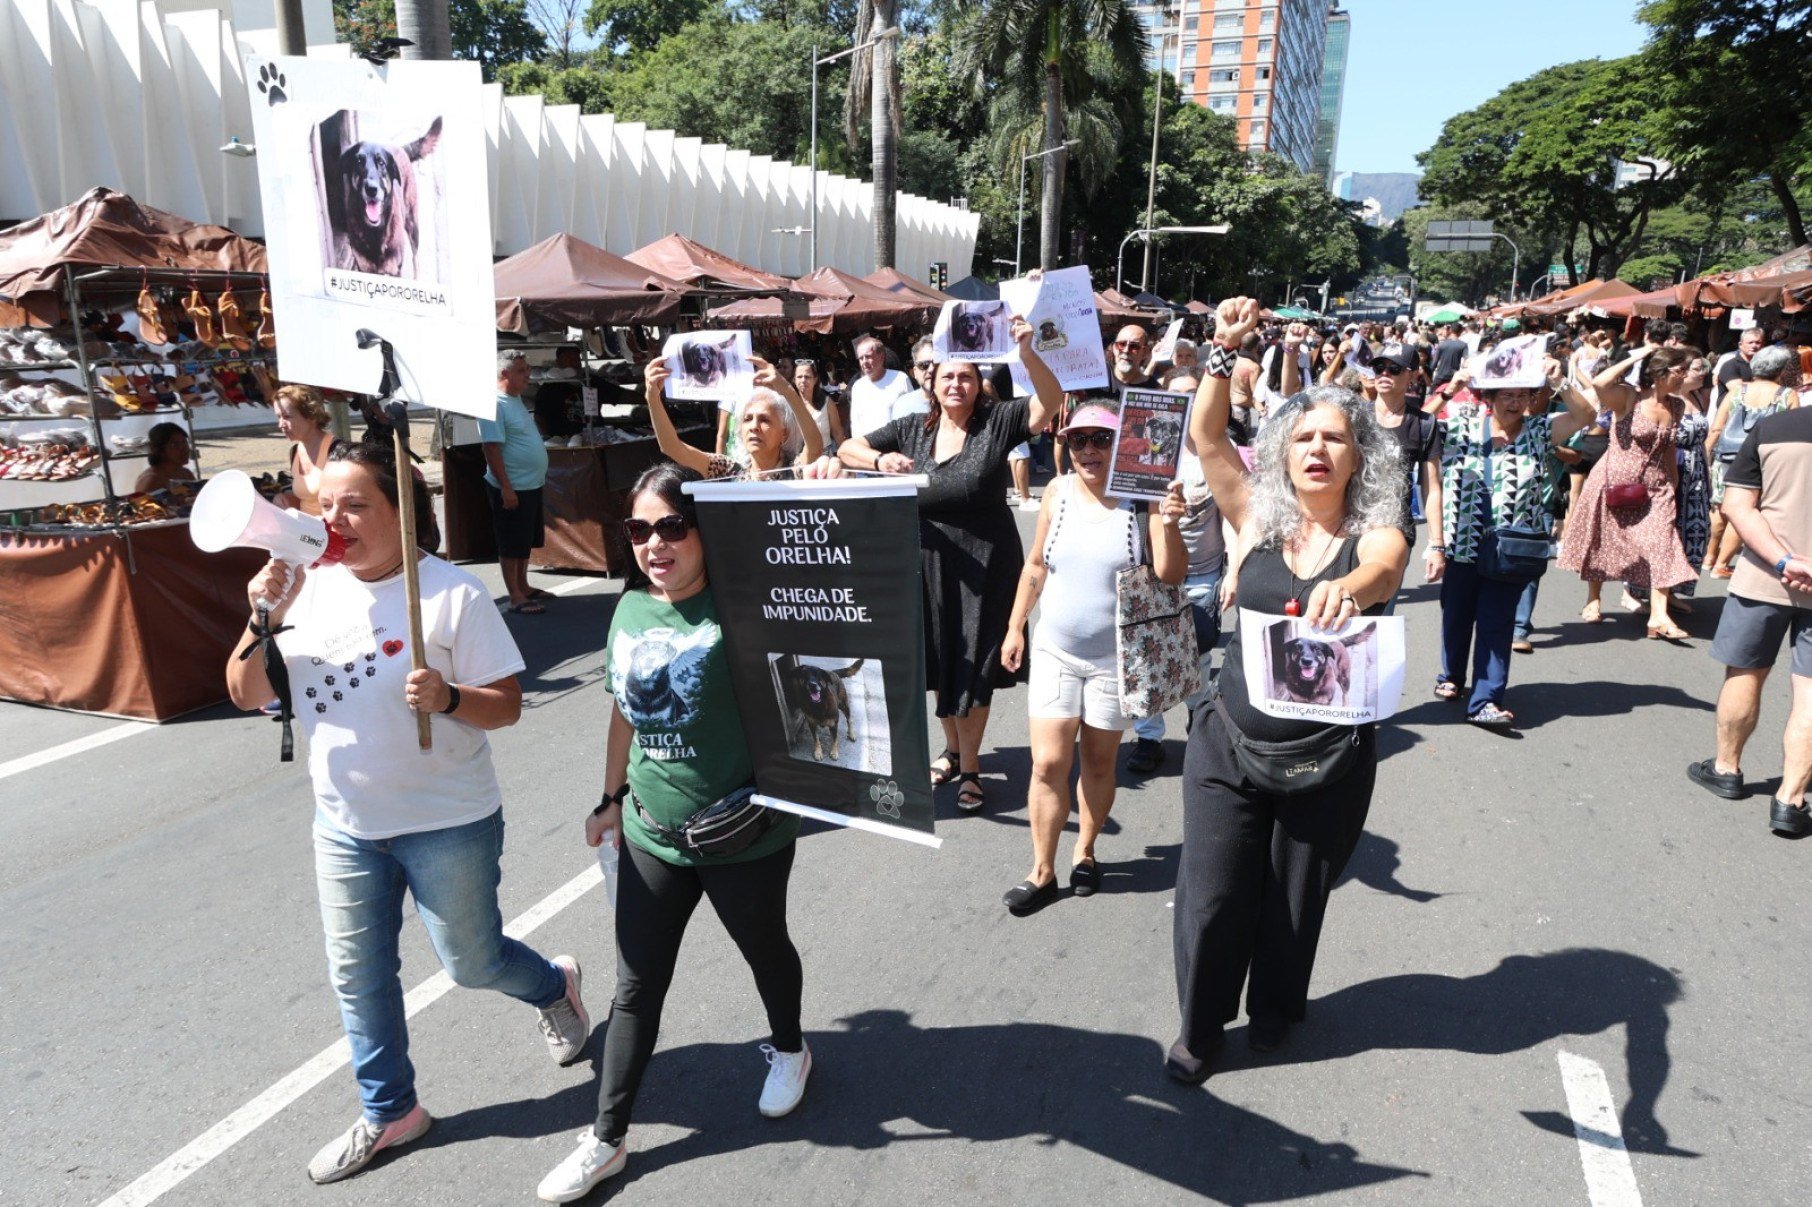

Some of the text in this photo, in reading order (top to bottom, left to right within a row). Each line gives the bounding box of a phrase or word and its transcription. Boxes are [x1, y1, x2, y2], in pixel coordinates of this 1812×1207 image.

[331, 276, 446, 305] #JUSTIÇAPORORELHA
[767, 508, 840, 529] JUSTIÇA
[781, 528, 829, 544] PELO
[765, 546, 851, 565] ORELHA!
[770, 587, 855, 604] CHEGA DE
[762, 604, 872, 623] IMPUNIDADE.
[1270, 703, 1371, 719] #JUSTIÇAPORORELHA
[640, 732, 683, 748] STIÇA
